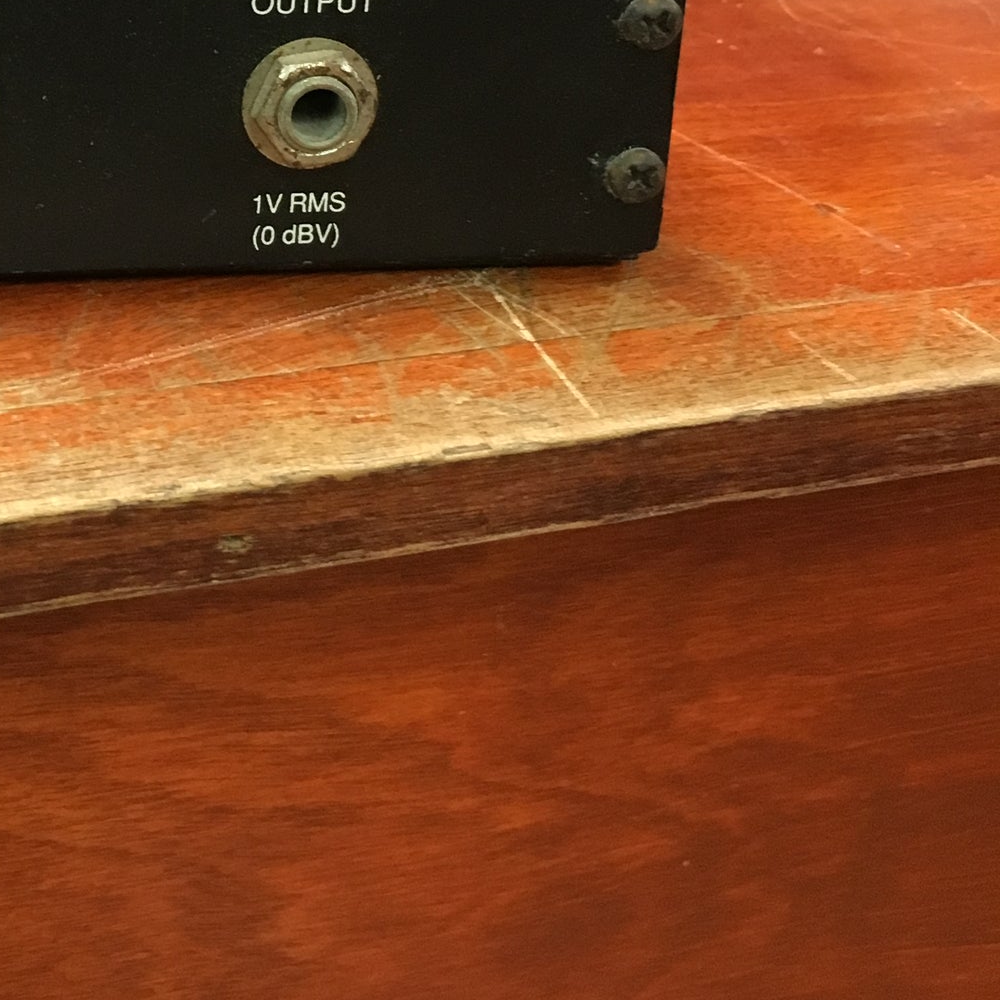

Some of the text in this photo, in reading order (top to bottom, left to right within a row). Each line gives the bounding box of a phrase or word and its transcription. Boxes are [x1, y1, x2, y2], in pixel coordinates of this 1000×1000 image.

[253, 192, 346, 214] 1V RMS
[252, 223, 340, 250] (0 dBV)
